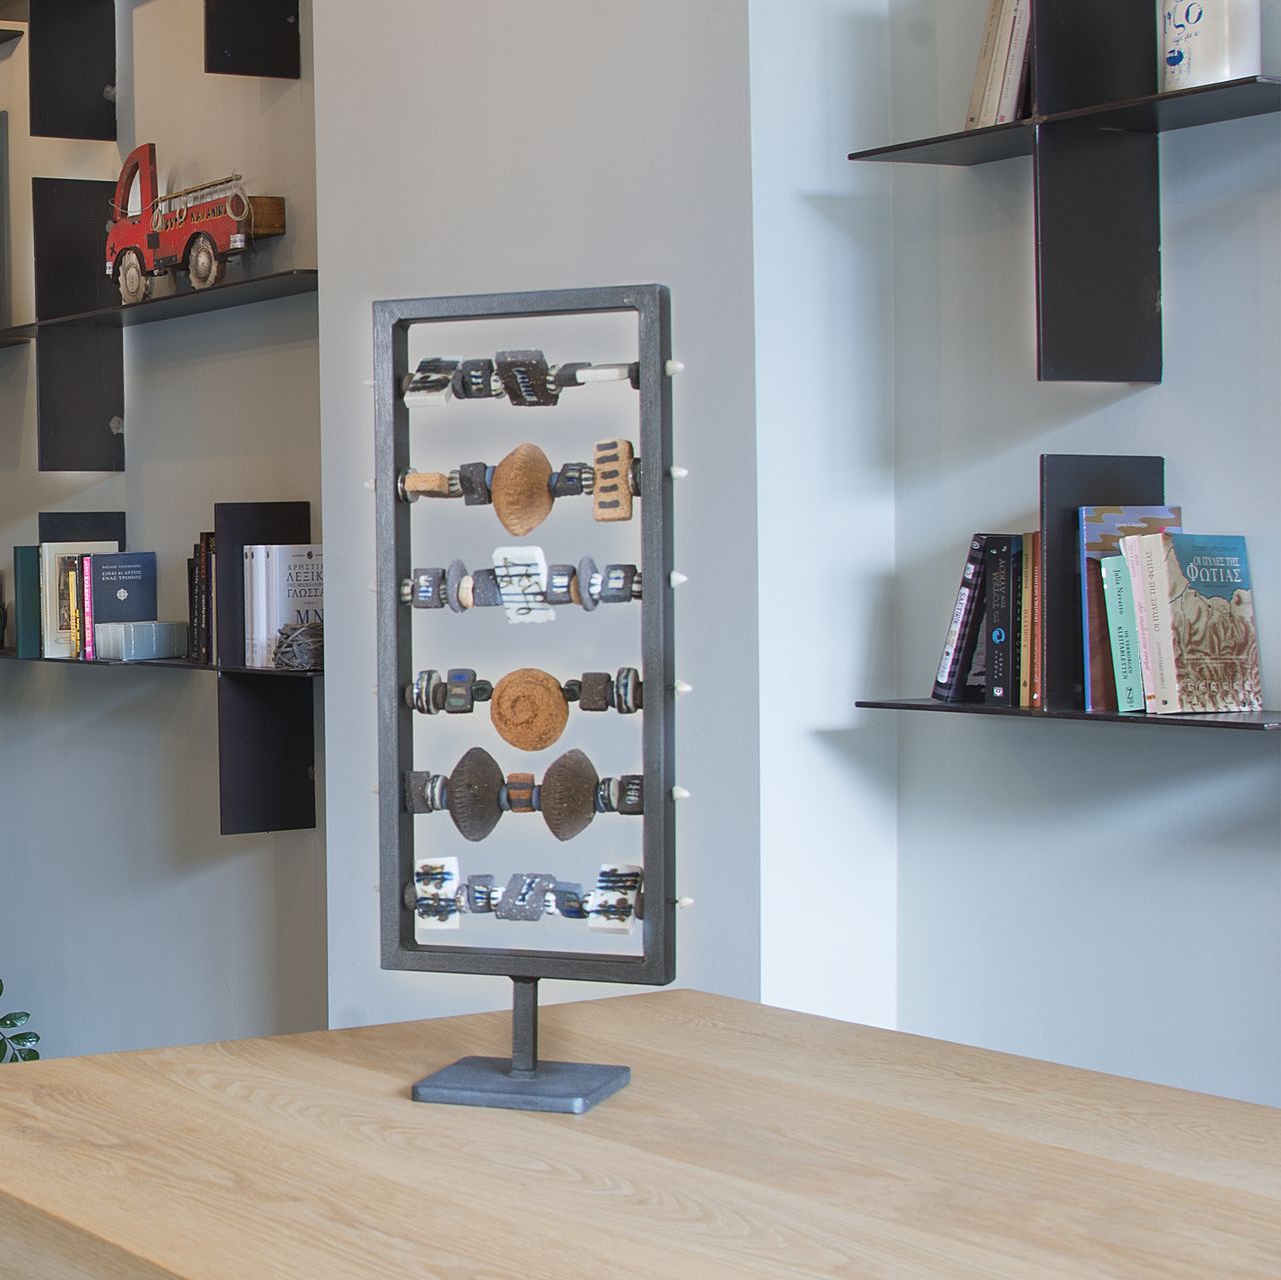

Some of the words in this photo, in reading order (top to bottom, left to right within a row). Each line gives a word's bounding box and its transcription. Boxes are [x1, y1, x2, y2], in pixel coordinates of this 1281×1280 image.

[1113, 569, 1122, 586] Julia
[1186, 562, 1242, 582] ΦΩΤΙΑΣ
[1116, 586, 1125, 615] Navarro
